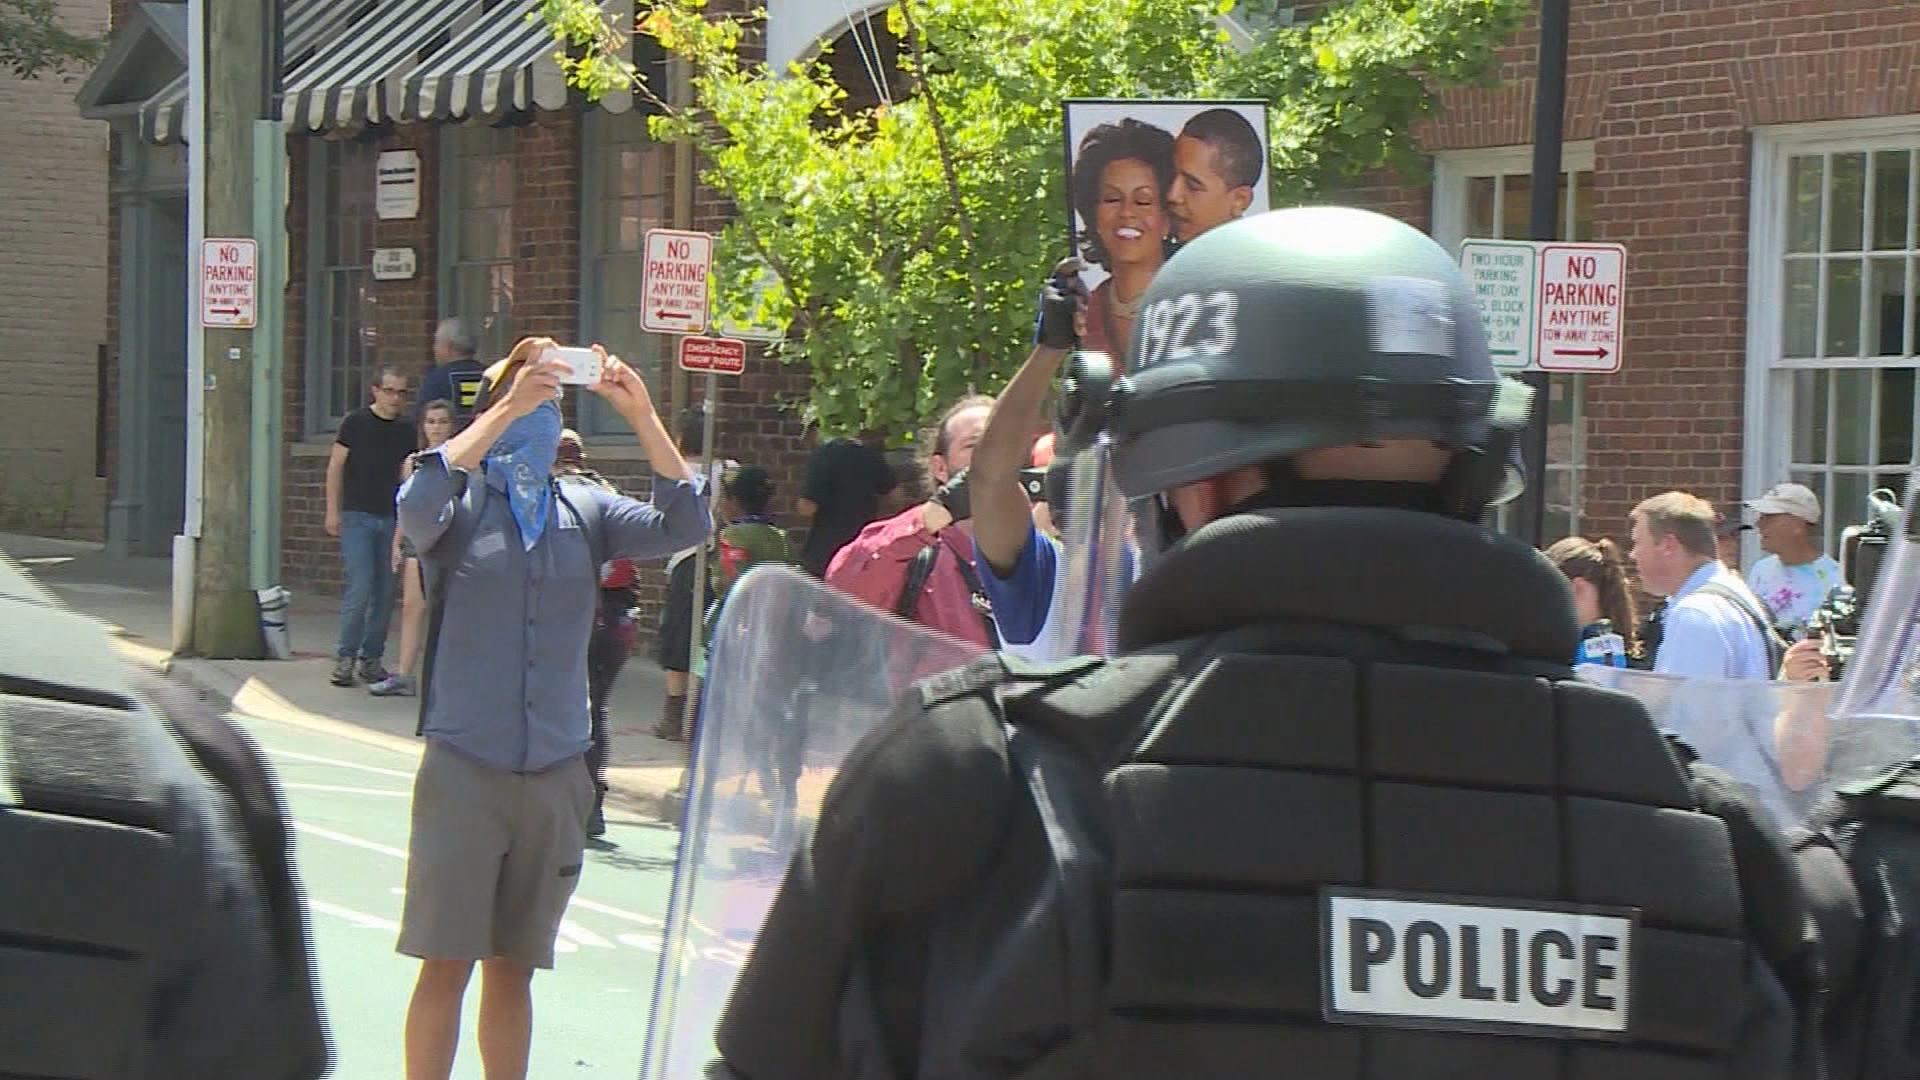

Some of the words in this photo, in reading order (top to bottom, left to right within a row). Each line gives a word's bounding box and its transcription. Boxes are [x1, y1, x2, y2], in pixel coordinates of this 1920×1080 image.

[220, 247, 239, 264] NO
[668, 241, 690, 260] NO
[1472, 253, 1491, 266] TWO
[1495, 254, 1525, 267] HOUR
[1568, 256, 1597, 279] NO
[206, 266, 253, 283] PARKING
[650, 261, 705, 282] PARKING
[1474, 269, 1518, 281] PARKING
[209, 283, 249, 296] ANYTIME
[653, 283, 700, 298] ANYTIME
[1545, 283, 1617, 306] PARKING
[1491, 301, 1524, 312] BLOCK
[1550, 311, 1610, 326] ANYTIME
[1138, 291, 1240, 368] 1923
[1591, 330, 1615, 342] ZONE
[1348, 916, 1621, 1011] POLICE
